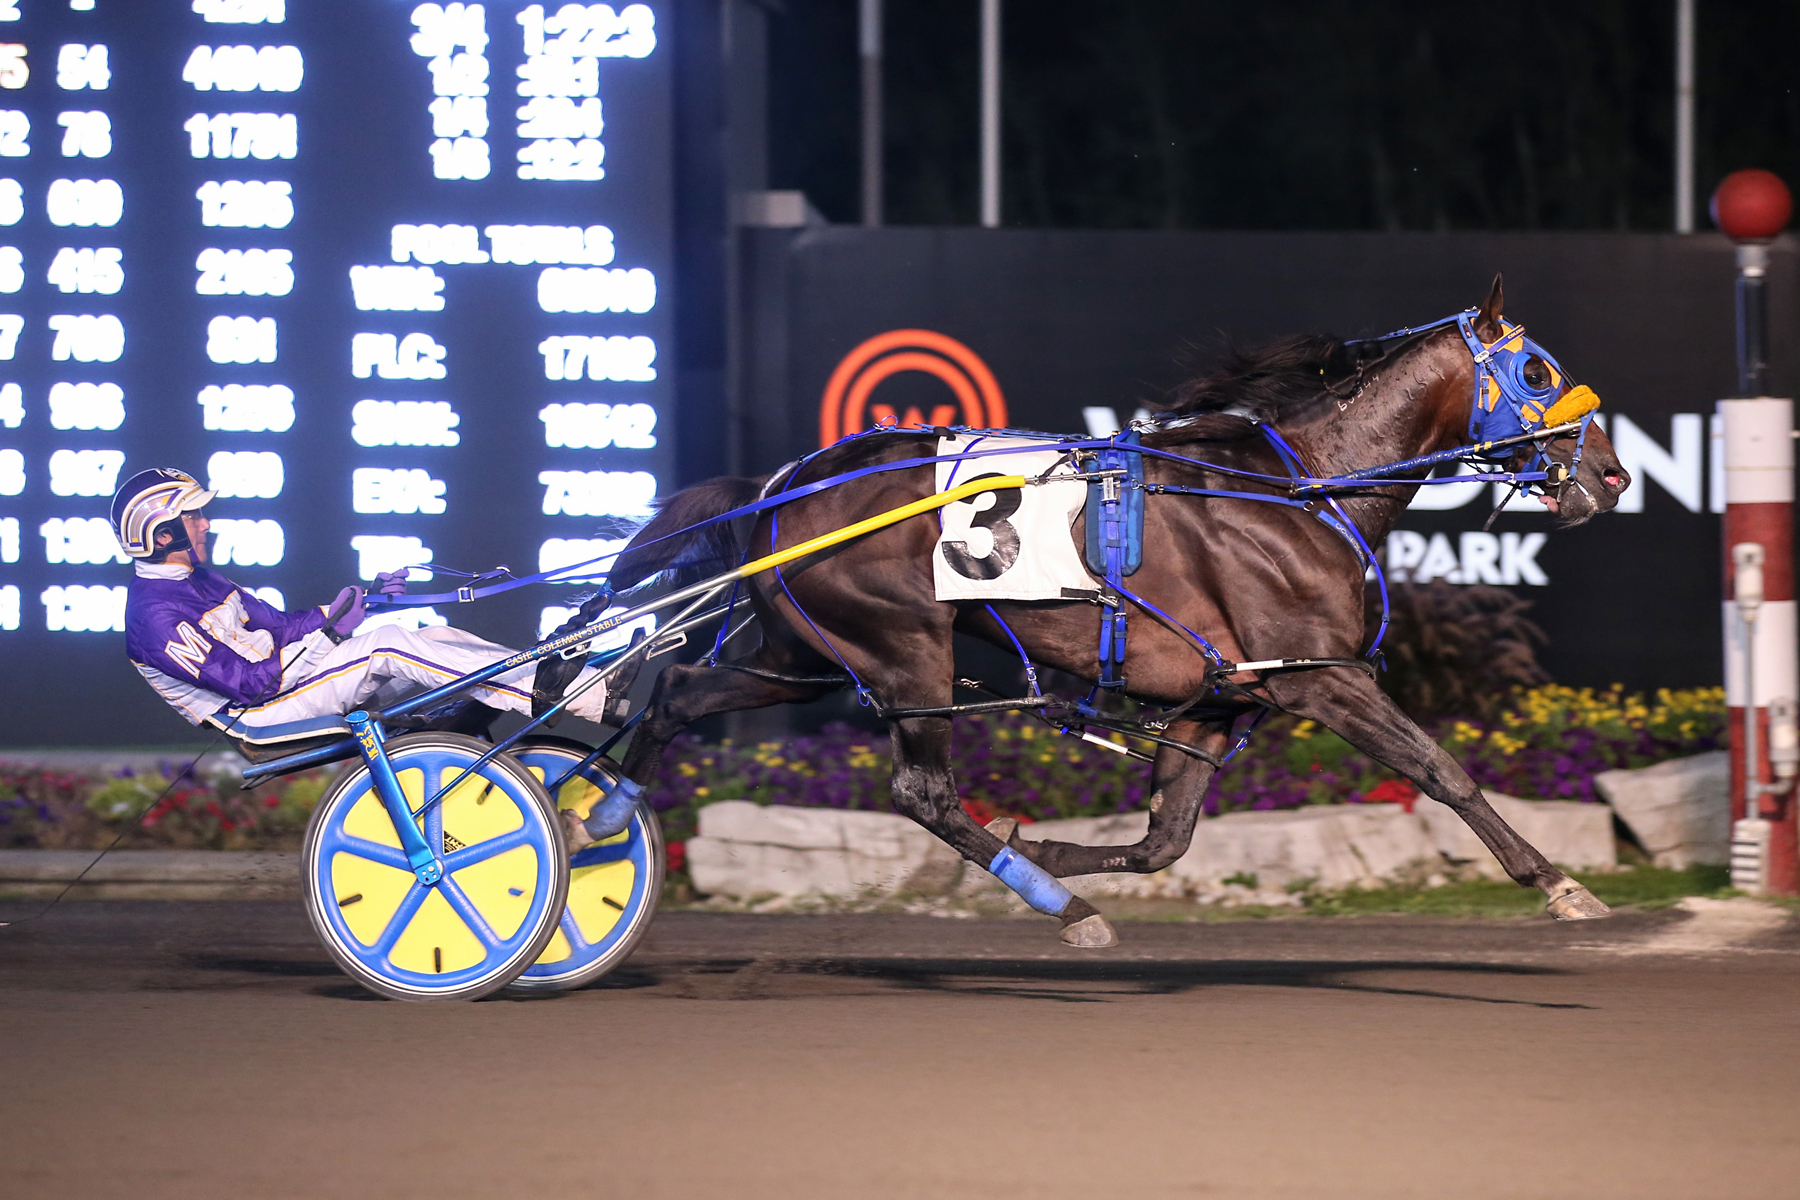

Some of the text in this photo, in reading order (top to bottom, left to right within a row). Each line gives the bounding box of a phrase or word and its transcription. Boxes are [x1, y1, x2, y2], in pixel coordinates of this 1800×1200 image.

[57, 43, 111, 90] 54
[392, 224, 489, 264] POOL
[47, 247, 125, 294] 415
[352, 332, 447, 380] PLC:
[941, 471, 1021, 580] 3
[1386, 530, 1549, 586] PARK
[164, 620, 213, 680] M
[505, 649, 534, 668] CASIE
[536, 630, 584, 655] COLEMAN
[586, 615, 623, 636] STABLE
